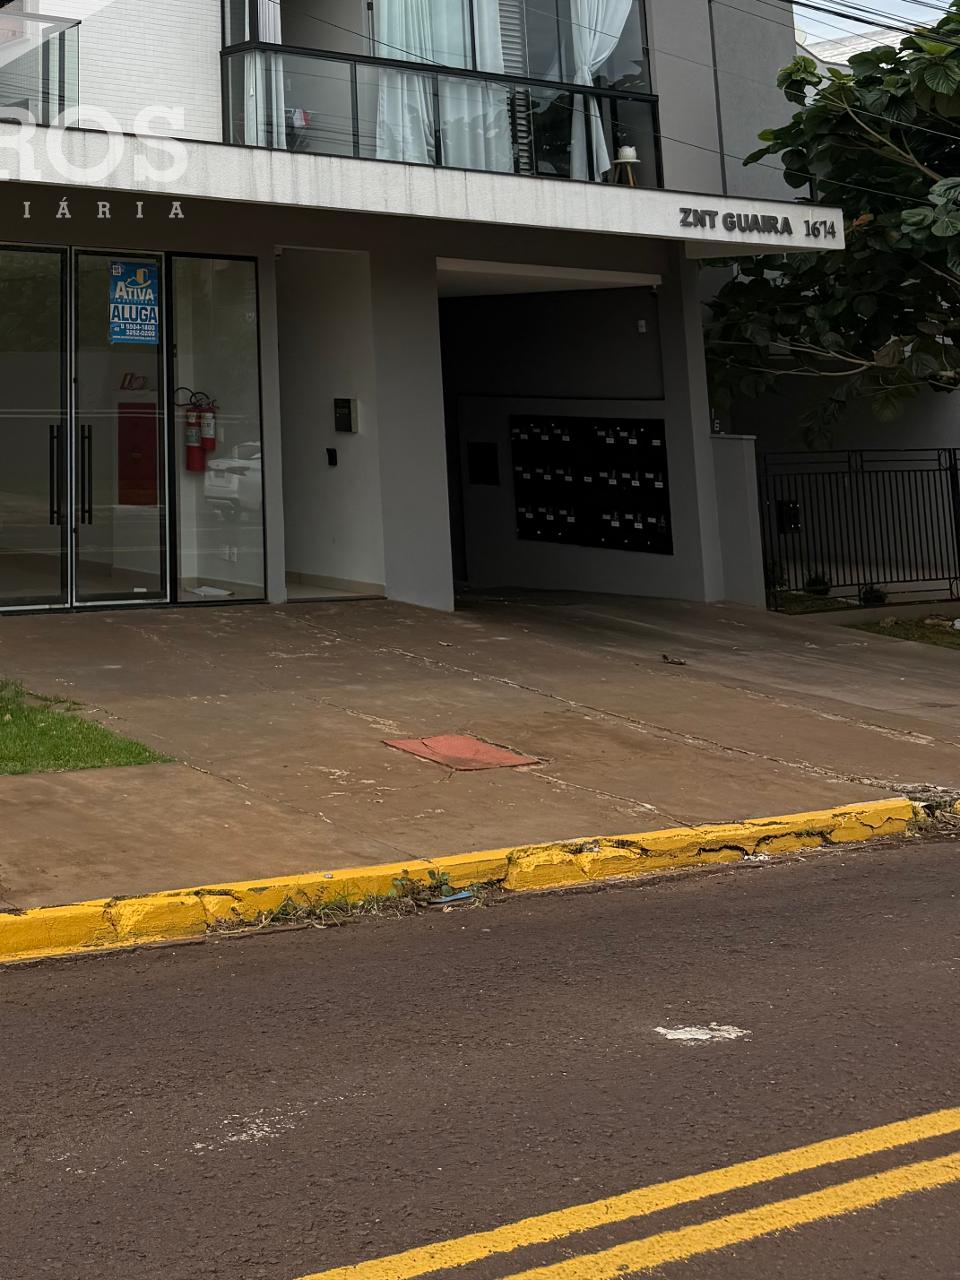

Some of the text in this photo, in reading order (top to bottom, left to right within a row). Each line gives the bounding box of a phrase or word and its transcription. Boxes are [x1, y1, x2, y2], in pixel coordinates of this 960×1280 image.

[679, 207, 836, 239] ZNT GUAIRA 1674
[111, 304, 158, 324] ALUGA
